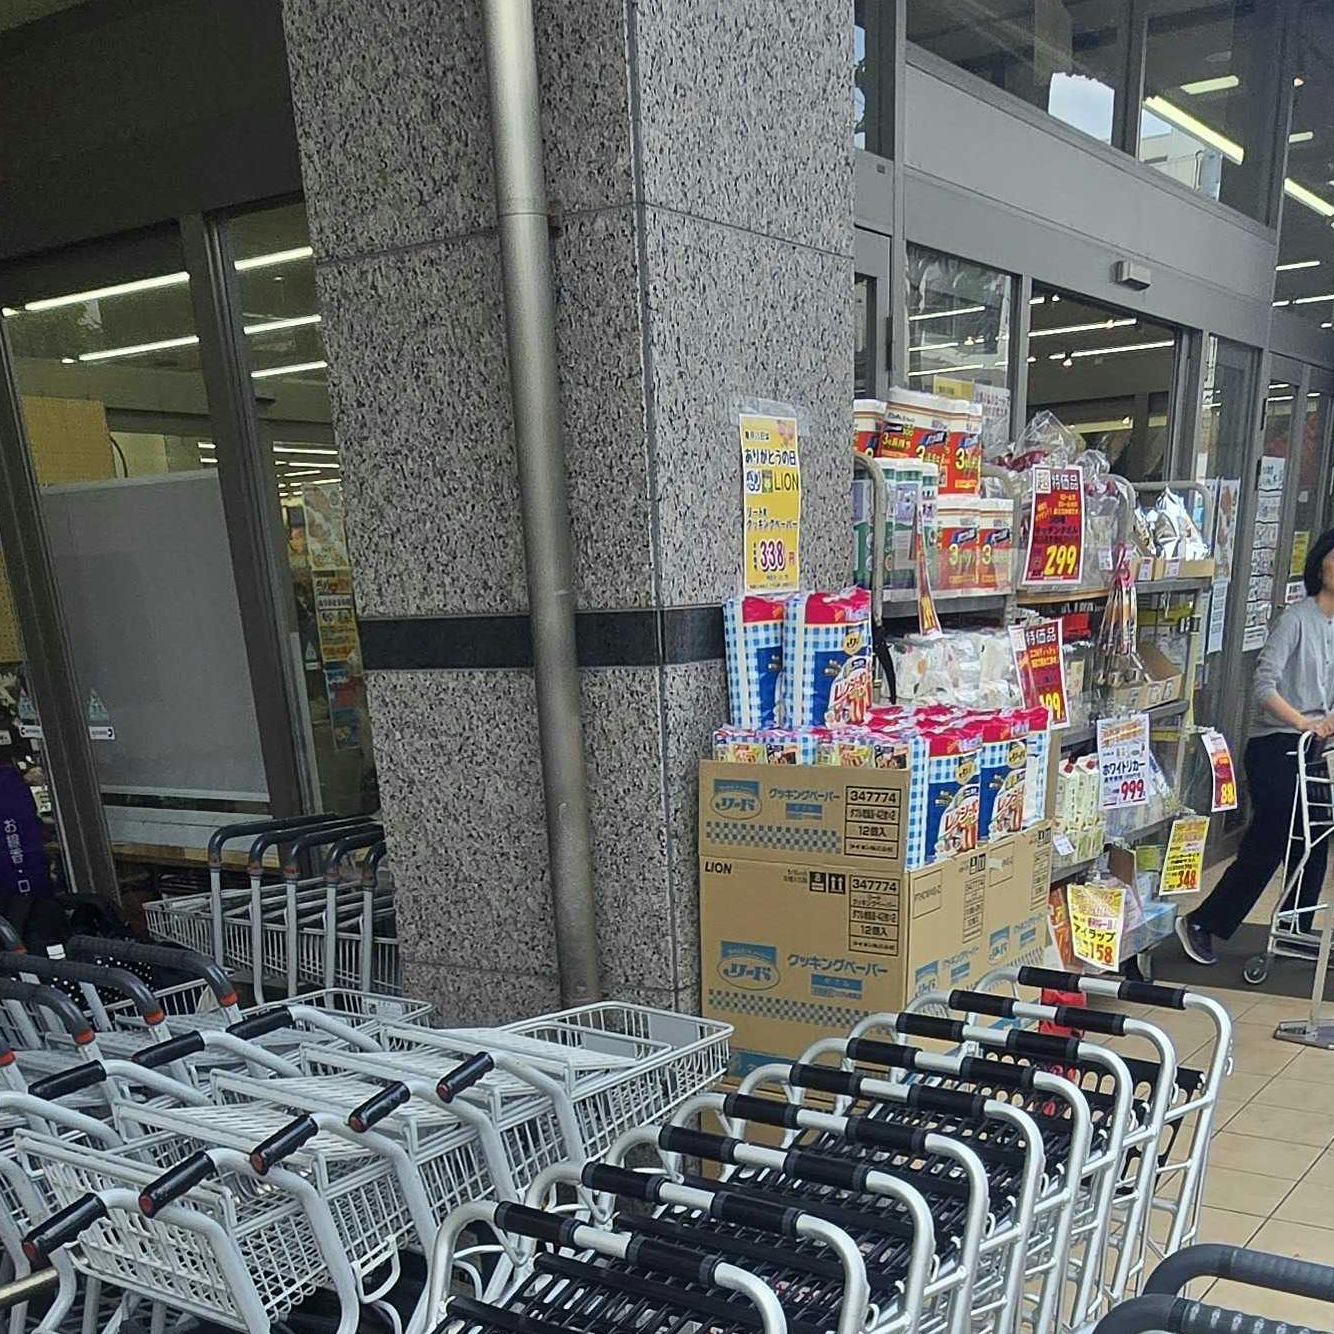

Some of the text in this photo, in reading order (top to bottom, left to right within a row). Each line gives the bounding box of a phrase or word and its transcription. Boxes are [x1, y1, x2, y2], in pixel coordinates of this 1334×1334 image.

[745, 450, 797, 465] ありがとうの日
[774, 473, 799, 491] LION
[1052, 473, 1079, 490] 特価品
[747, 518, 799, 531] クッキングペーパー
[760, 540, 786, 572] 338
[1044, 545, 1078, 575] 299
[1026, 626, 1057, 646] 特価品
[1102, 760, 1147, 777] ホワイトリカー
[769, 788, 841, 802] クッキングペーパー
[850, 790, 897, 804] 347774
[1121, 779, 1145, 801] 999
[858, 826, 888, 838] 12個入
[705, 861, 733, 875] LION
[852, 878, 898, 893] 347774
[860, 925, 889, 938] 12個入
[1073, 922, 1117, 944] アイラップ
[1090, 942, 1113, 964] 158
[723, 963, 773, 982] リード
[787, 954, 889, 977] クッキングペーパー
